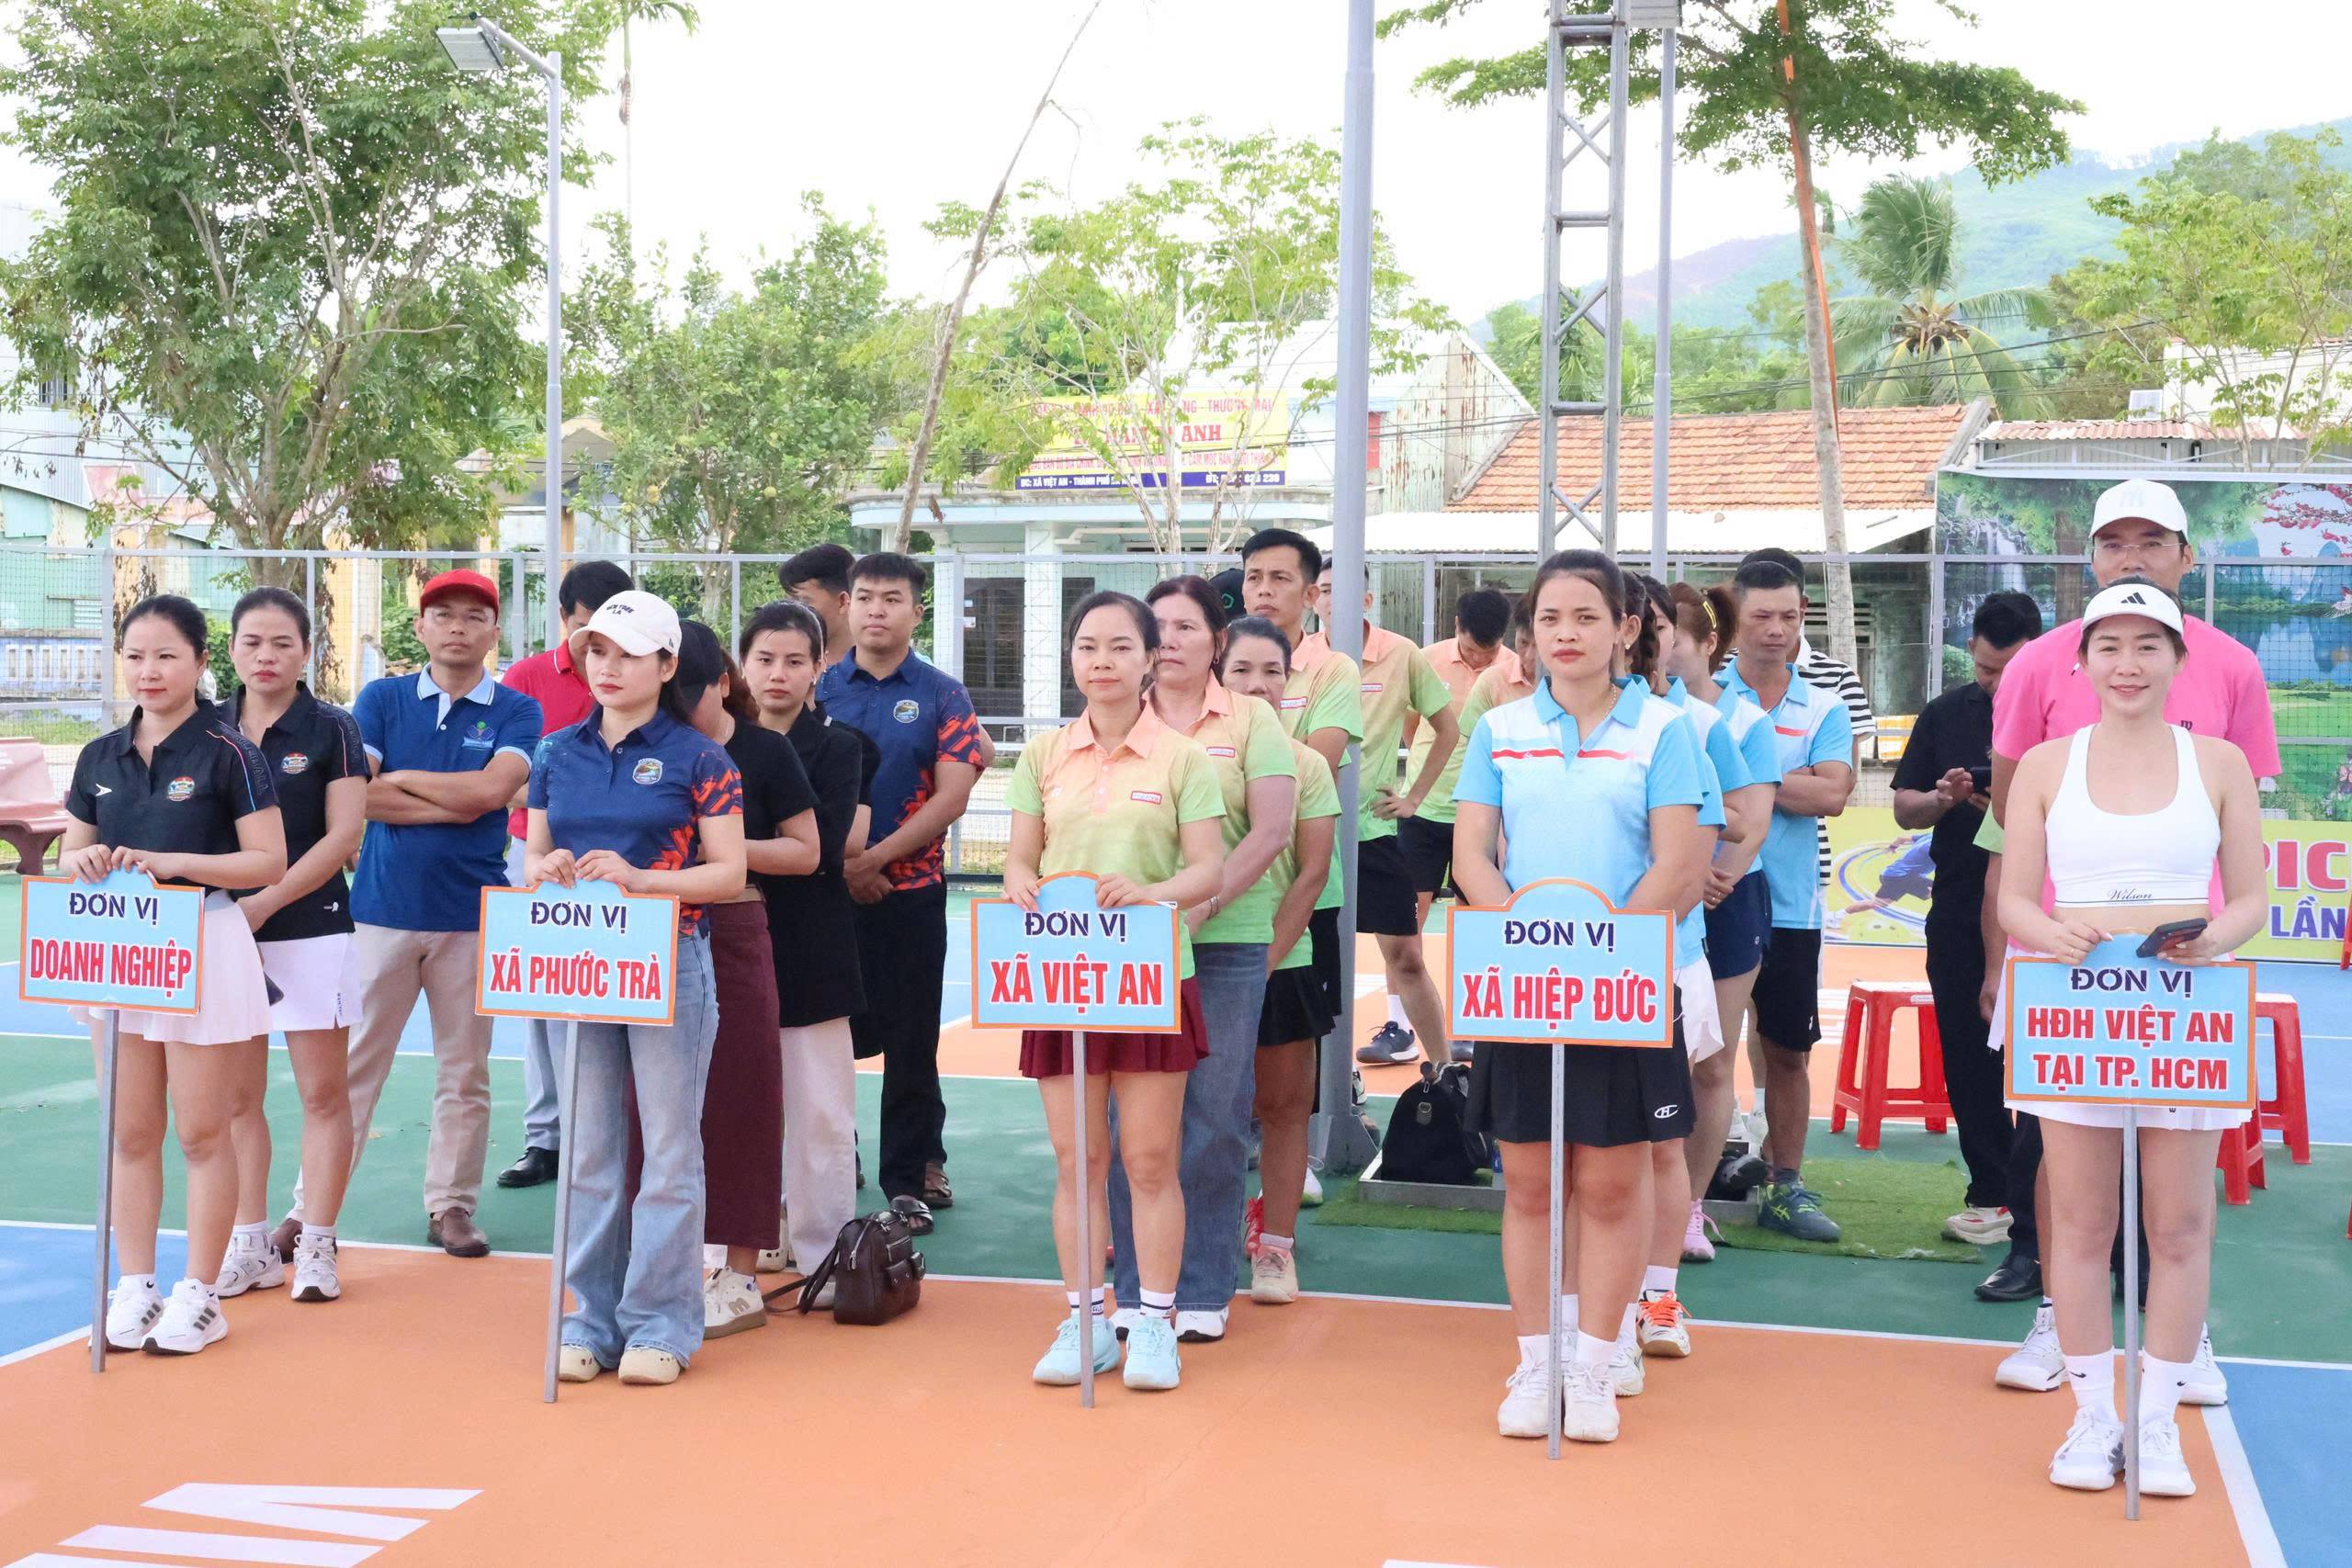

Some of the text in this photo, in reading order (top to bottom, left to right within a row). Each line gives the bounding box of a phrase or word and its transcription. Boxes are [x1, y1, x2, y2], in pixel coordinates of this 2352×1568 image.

[1182, 424, 1221, 442] ANH
[1043, 476, 1057, 489] VIỆT
[1057, 477, 1069, 487] AN
[2264, 841, 2346, 890] IC
[70, 892, 158, 925] ĐƠN VỊ
[2108, 888, 2153, 901] Wilson
[531, 901, 627, 934] ĐƠN VỊ
[1024, 911, 1125, 942] ĐƠN VỊ
[2271, 896, 2346, 939] LẦN
[1505, 919, 1614, 953] ĐƠN VỊ
[30, 939, 192, 998] DOANH NGHIỆP
[490, 947, 662, 1000] XÃ PHƯỚC TRÀ
[990, 953, 1161, 1013] XÃ VIỆT AN
[2071, 967, 2191, 998] ĐƠN VỊ
[1462, 966, 1657, 1030] XÃ HIỆP ĐỨC
[2028, 1004, 2233, 1047] HĐH VIỆT AN
[2033, 1055, 2227, 1091] TẠI TP. HCM
